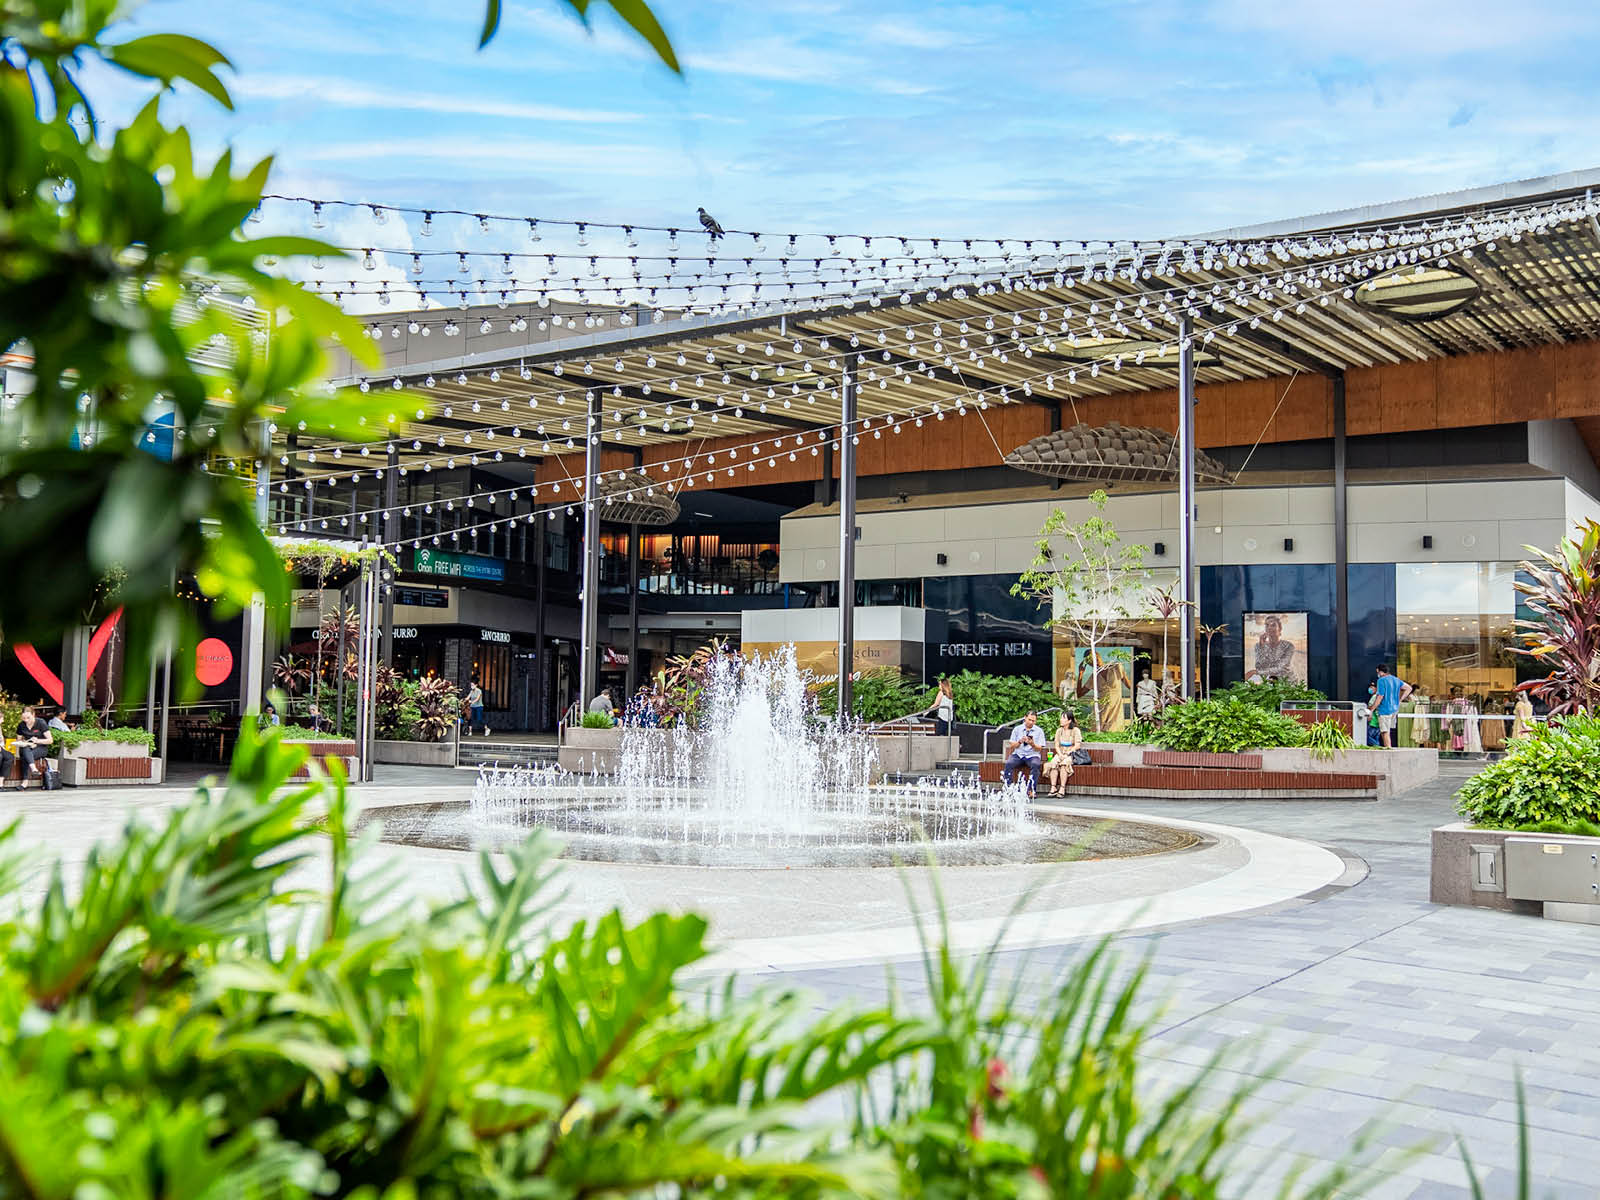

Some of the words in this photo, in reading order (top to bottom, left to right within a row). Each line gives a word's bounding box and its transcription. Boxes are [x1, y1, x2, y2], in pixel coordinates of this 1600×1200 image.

[435, 561, 449, 574] FREE
[391, 627, 418, 639] HURRO
[832, 647, 860, 660] Gg
[861, 646, 880, 657] cha
[940, 643, 1000, 656] FOREVER
[1004, 642, 1032, 656] NEW
